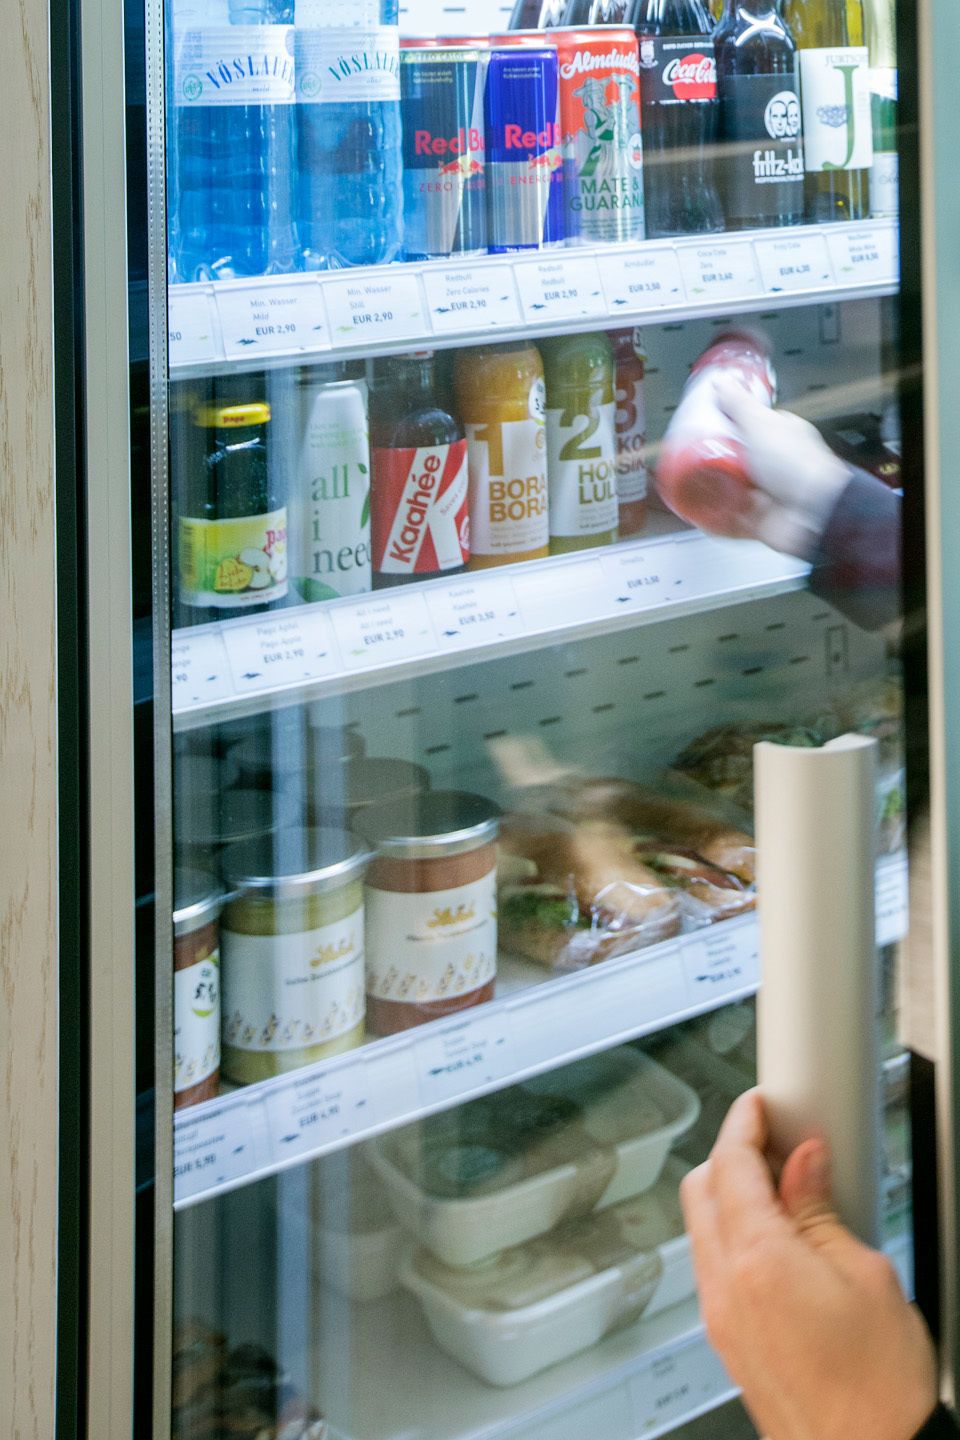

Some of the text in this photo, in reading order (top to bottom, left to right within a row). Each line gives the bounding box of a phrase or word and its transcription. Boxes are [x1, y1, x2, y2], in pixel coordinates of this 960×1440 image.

[415, 128, 465, 155] Red
[505, 123, 551, 149] Red
[581, 177, 628, 194] MATE
[544, 291, 560, 300] EUR
[628, 284, 643, 292] EUR
[451, 299, 487, 310] EUR 2,90
[353, 312, 393, 324] EUR 2,90
[256, 324, 296, 335] EUR 2,90
[559, 409, 602, 461] 2
[474, 422, 504, 477] 1
[312, 463, 350, 501] all
[389, 455, 441, 564] Kaahée
[313, 510, 321, 542] i
[364, 634, 383, 645] EUR
[264, 653, 283, 663] EUR
